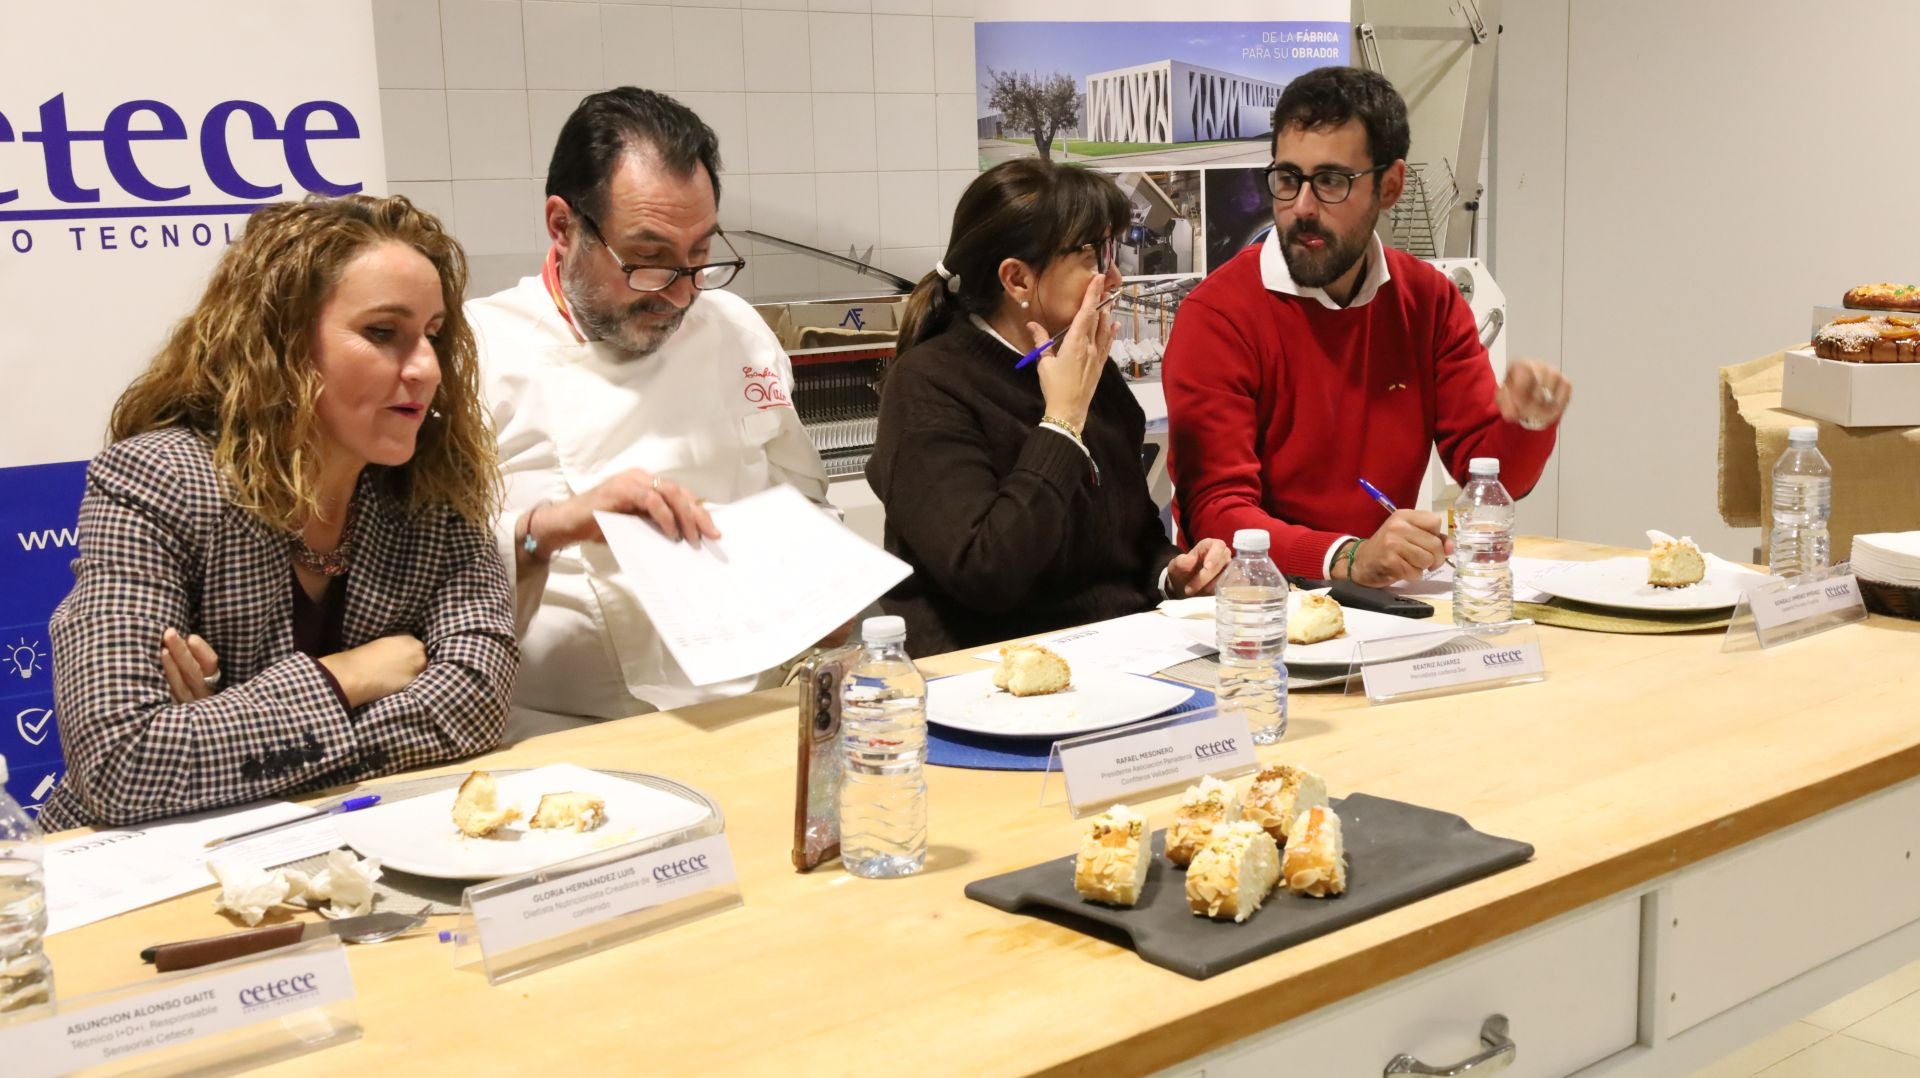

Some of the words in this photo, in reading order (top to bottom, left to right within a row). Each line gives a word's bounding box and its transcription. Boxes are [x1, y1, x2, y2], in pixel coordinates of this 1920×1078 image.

[1262, 31, 1277, 43] DE
[1280, 31, 1294, 43] LA
[1296, 28, 1339, 43] FÁBRICA
[1242, 47, 1271, 59] PARA
[1273, 47, 1289, 59] SU
[1291, 47, 1340, 59] OBRADOR
[1413, 662, 1435, 672] BEATRIZ
[1482, 649, 1522, 666] cetece
[1116, 753, 1139, 765] RAFAEL
[1140, 746, 1174, 760] MESONERO
[1194, 738, 1237, 760] cetece
[652, 854, 710, 882] cetece
[533, 888, 564, 904] GLORIA
[617, 867, 636, 881] LUIS
[605, 879, 640, 896] Creadora
[572, 901, 611, 919] contenido
[239, 972, 317, 1006] cetece
[66, 1011, 131, 1036] ASUNCION
[134, 999, 181, 1019] ALONSO
[184, 989, 216, 1006] GAITE
[150, 1005, 218, 1030] Responsable
[103, 1036, 154, 1058] Sensorial
[156, 1026, 194, 1044] Cetece
